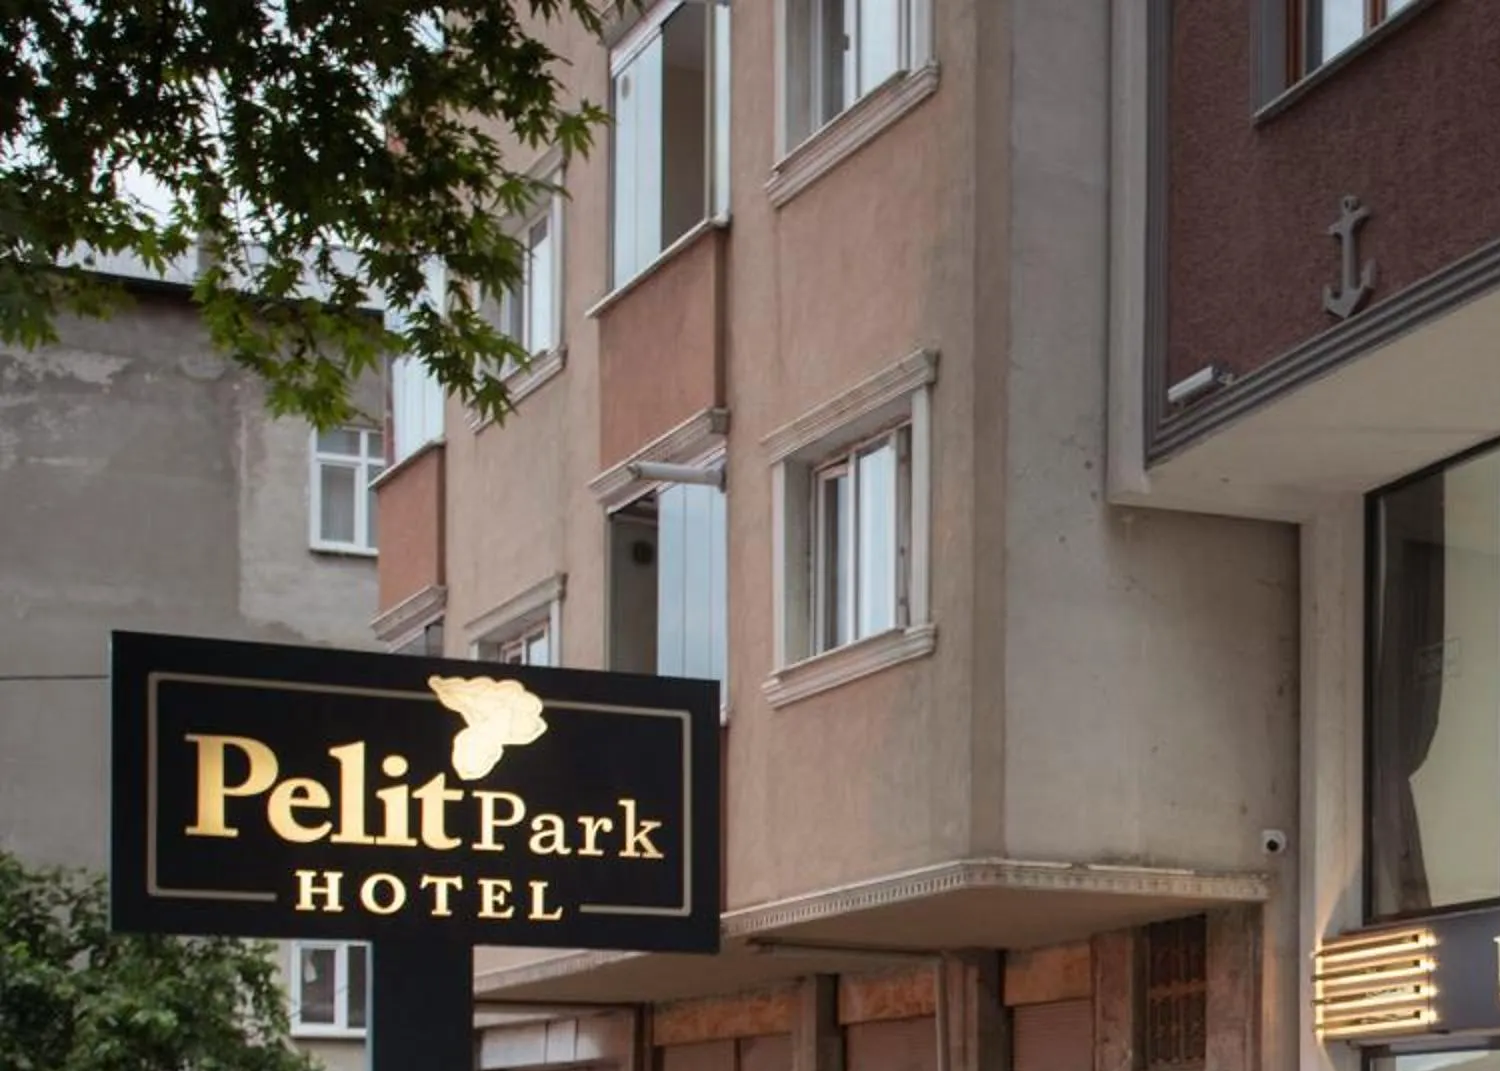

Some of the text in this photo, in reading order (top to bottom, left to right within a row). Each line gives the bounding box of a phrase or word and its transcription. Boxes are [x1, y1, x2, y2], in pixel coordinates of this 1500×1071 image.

[185, 734, 664, 859] Pelit Park
[294, 869, 564, 920] HOTEL
